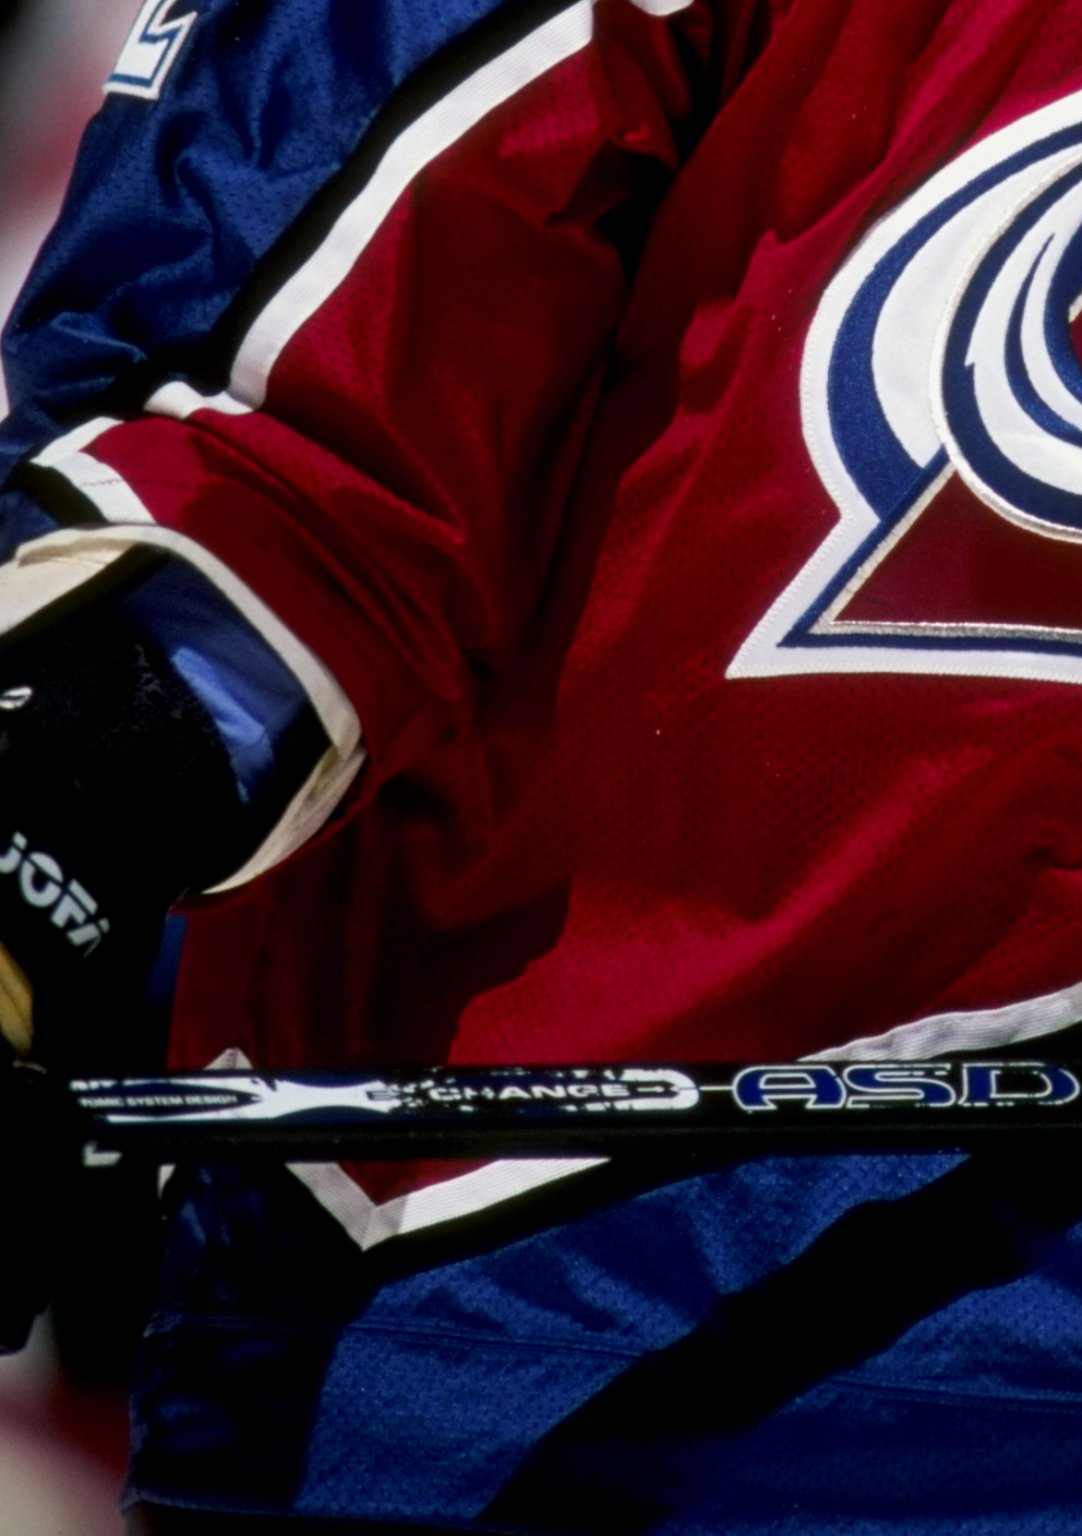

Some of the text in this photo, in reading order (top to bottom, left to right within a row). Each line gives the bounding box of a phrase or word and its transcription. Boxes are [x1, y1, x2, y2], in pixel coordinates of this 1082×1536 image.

[79, 1093, 238, 1108] TOMIC SYSTEM DESIGN
[733, 1063, 1080, 1110] ASD
